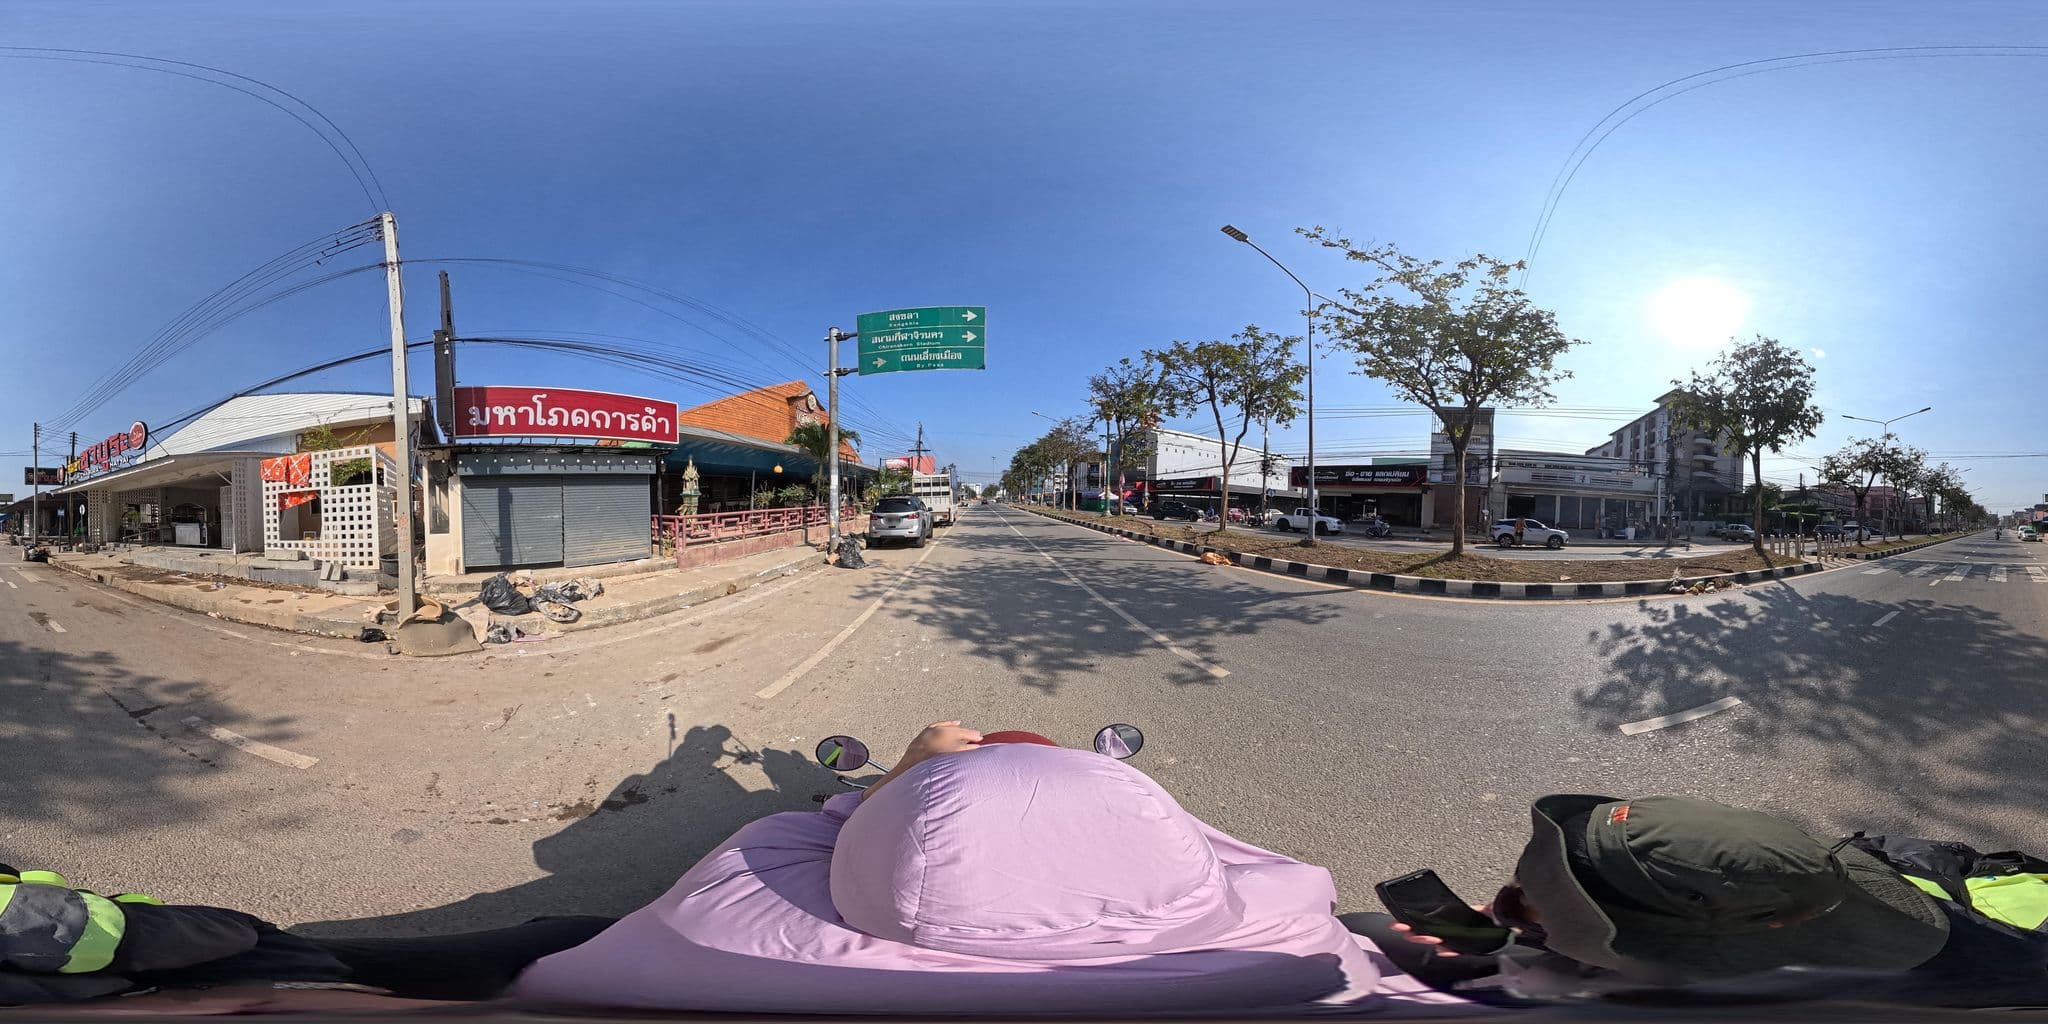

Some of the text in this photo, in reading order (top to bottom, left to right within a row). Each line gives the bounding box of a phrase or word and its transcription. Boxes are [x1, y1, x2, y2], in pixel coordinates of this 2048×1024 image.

[889, 312, 919, 321] สงขลา
[901, 349, 962, 361] ถนนเลี่ยงเมือง
[468, 393, 670, 434] มหาโภคการค้า
